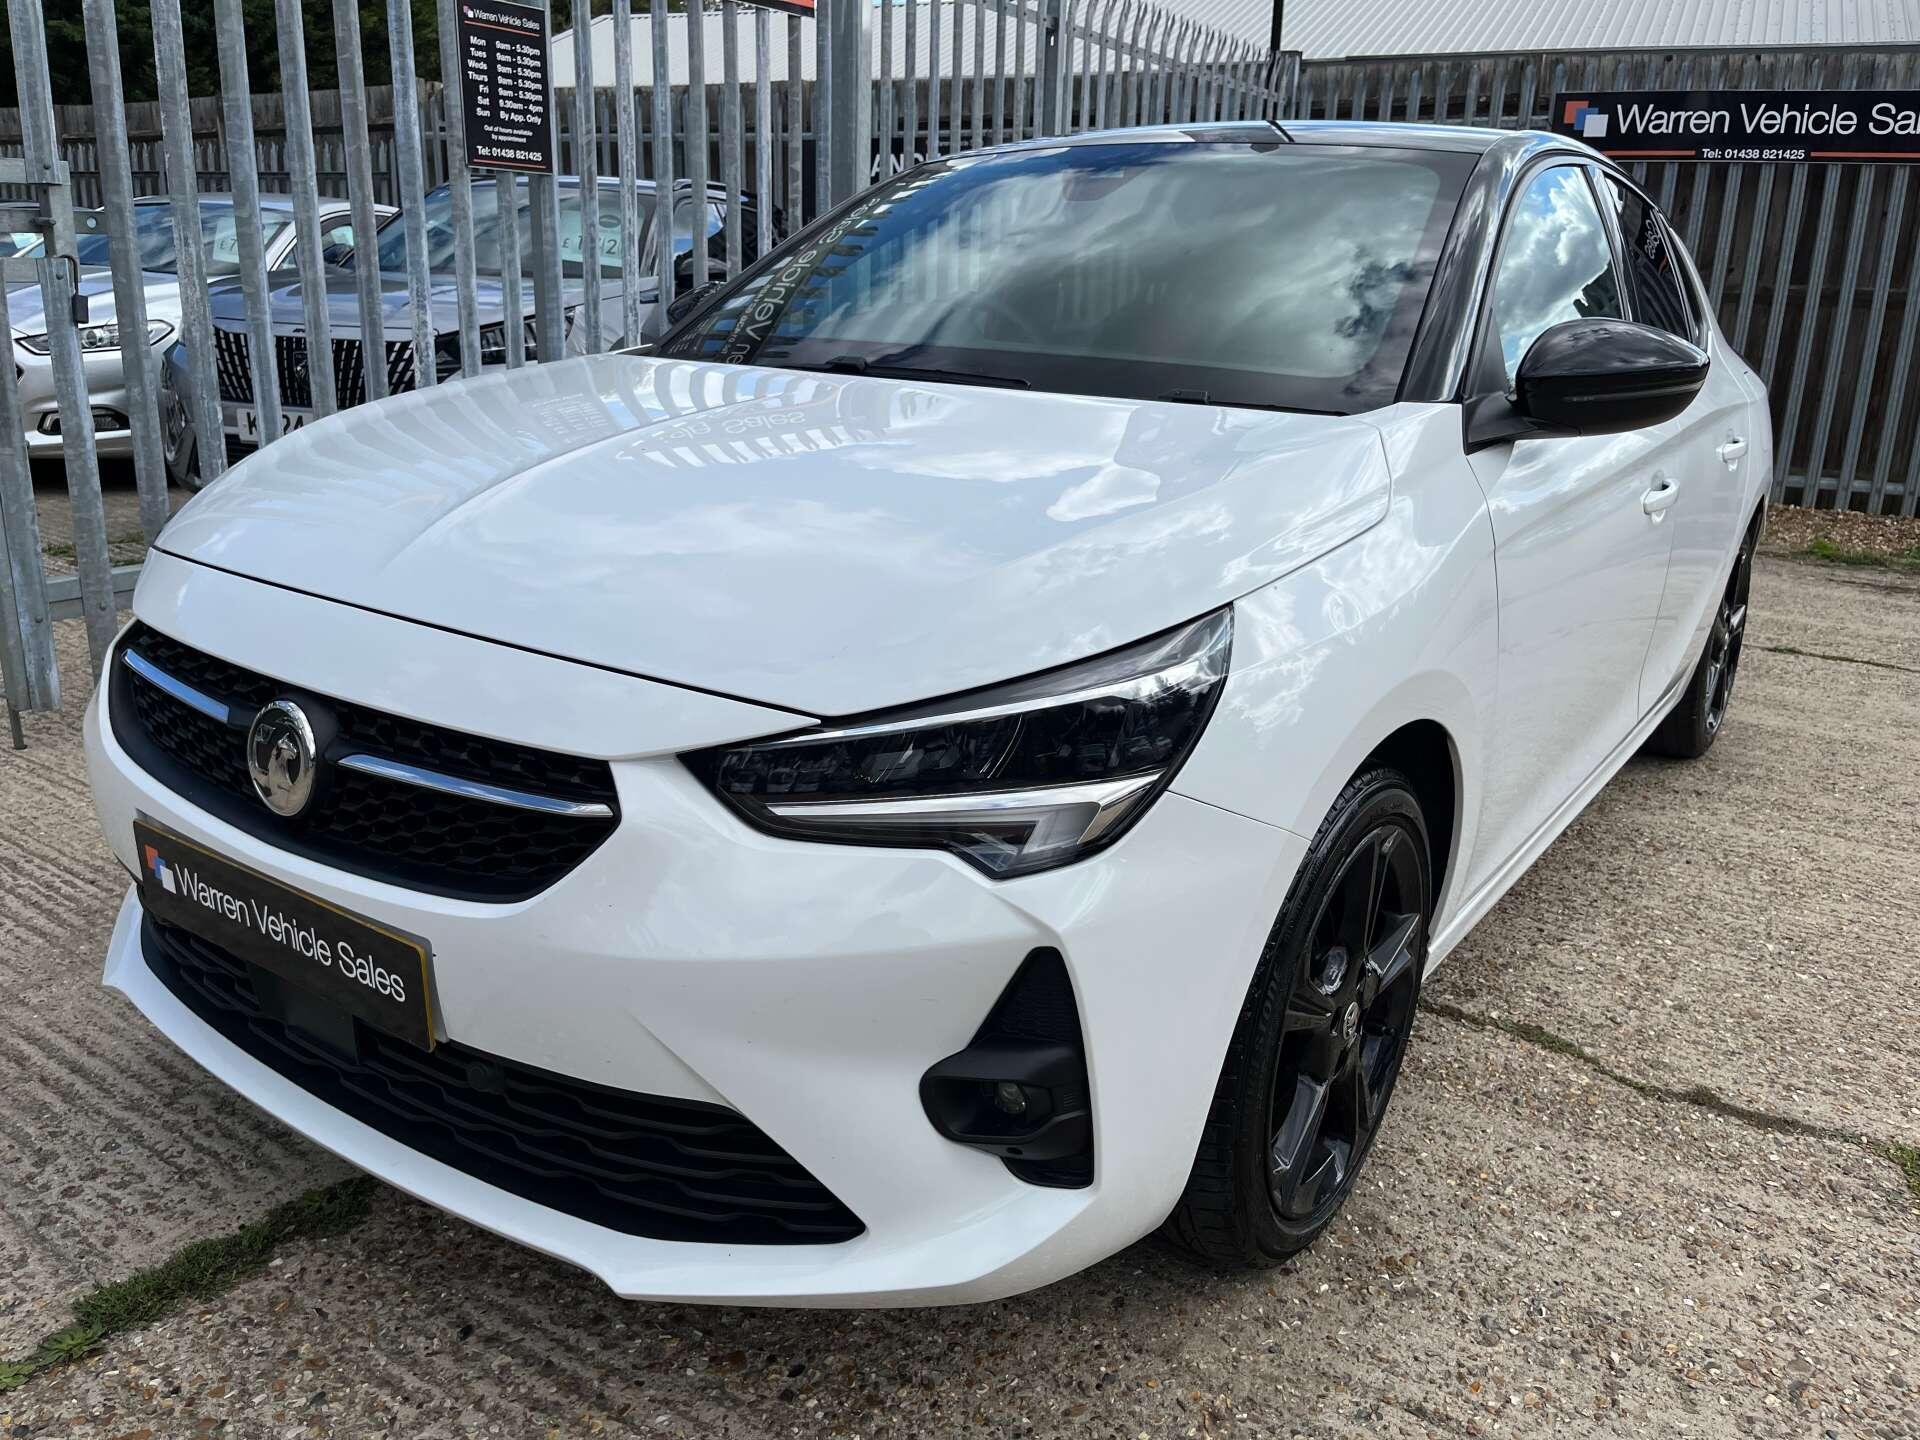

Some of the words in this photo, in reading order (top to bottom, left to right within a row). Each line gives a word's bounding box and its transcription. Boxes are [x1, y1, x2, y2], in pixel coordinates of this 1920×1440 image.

[474, 9, 498, 22] Warren
[498, 14, 521, 26] Vehicle
[522, 19, 540, 30] Sales
[470, 36, 486, 46] Mon
[496, 41, 510, 50] 9am
[516, 44, 540, 56] 5.30pm
[470, 48, 487, 58] Tues
[496, 53, 511, 62] 9am
[517, 56, 540, 68] 5.30pm
[468, 59, 487, 70] Weds
[497, 64, 512, 74] 9am
[518, 68, 541, 79] 5.30pm
[467, 71, 488, 82] Thurs
[498, 76, 512, 86] 9am
[518, 78, 542, 90] 5.30pm
[479, 84, 489, 94] Fri
[498, 88, 513, 97] 9am
[519, 91, 542, 102] 5.30pm
[478, 96, 490, 105] Sat
[499, 99, 523, 110] 9.30am
[529, 104, 543, 113] 4pm
[476, 108, 490, 117] Sun
[500, 111, 509, 121] By
[510, 113, 525, 122] App.
[526, 115, 541, 125] Only
[1616, 104, 1730, 134] Warren
[1740, 104, 1857, 135] Vehicle
[476, 146, 491, 156] Tel:
[492, 147, 514, 158] 01438
[516, 150, 542, 161] 821425
[1702, 148, 1722, 159] Tel:
[1724, 149, 1759, 159] 01438
[1762, 149, 1805, 159] 821425
[174, 863, 250, 927] Warren
[252, 899, 332, 966] Vehicle
[337, 941, 406, 1002] Sales
